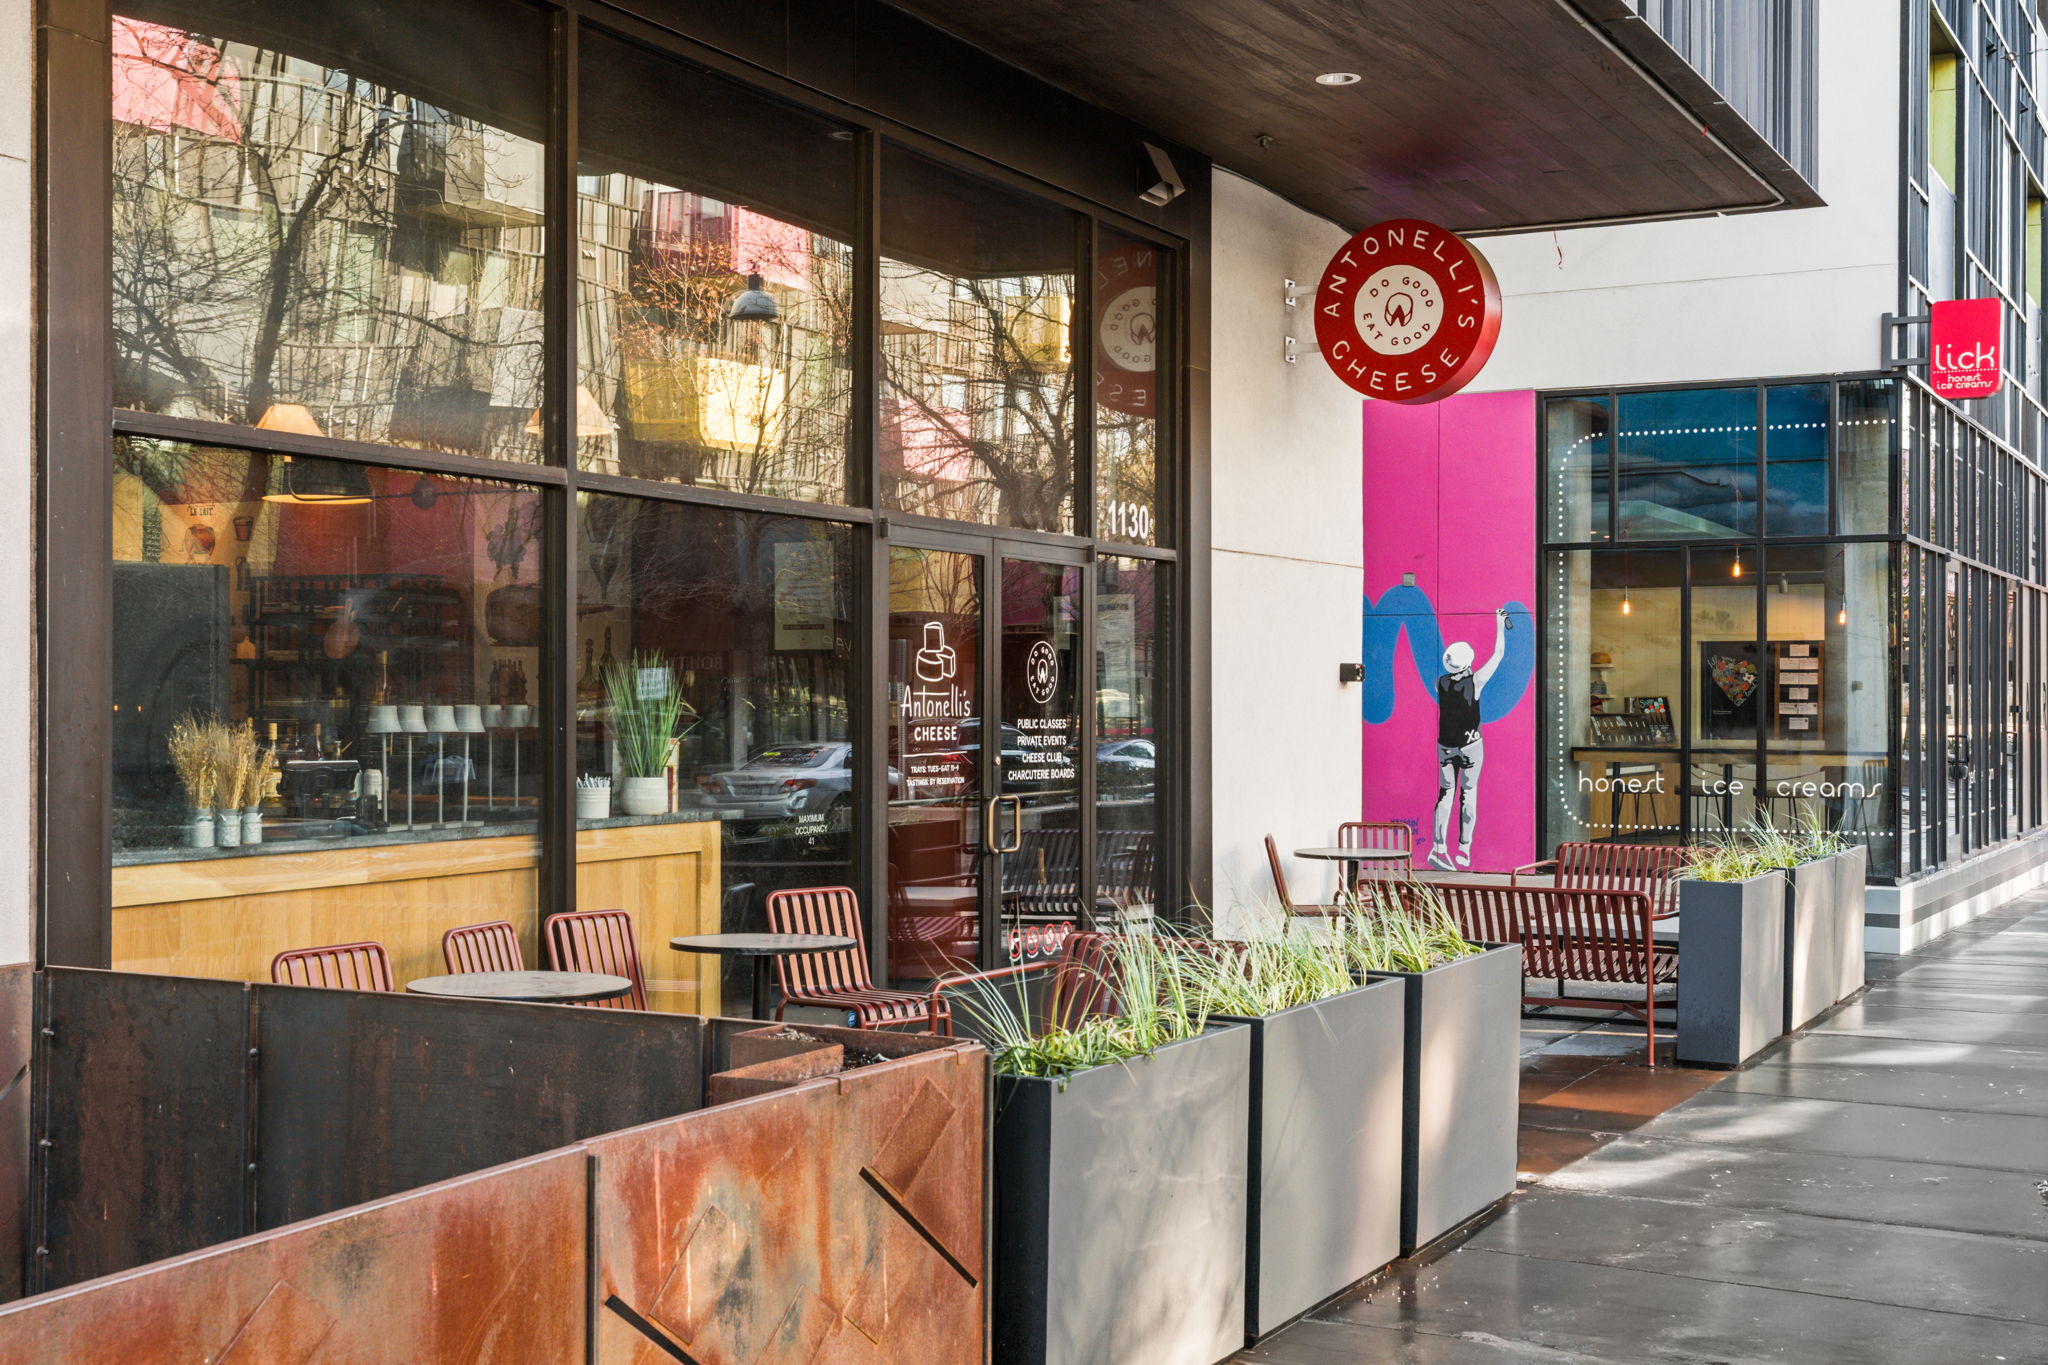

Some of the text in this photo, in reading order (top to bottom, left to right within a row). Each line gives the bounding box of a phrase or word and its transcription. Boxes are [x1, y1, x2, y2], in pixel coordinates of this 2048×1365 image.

[1323, 227, 1479, 328] ANTONELLI'S
[1370, 276, 1433, 307] DO GOOD
[1363, 312, 1430, 346] EAT GOOD
[1935, 342, 1995, 370] lick
[1332, 340, 1460, 392] CHEESE
[1947, 372, 1981, 382] honest
[1936, 380, 1993, 390] ice creams
[1108, 500, 1149, 540] 1130
[1041, 646, 1055, 666] GOOD
[1041, 676, 1055, 696] GOOD
[900, 683, 971, 717] Antonelli's
[1017, 718, 1067, 729] PUBLIC CLASSES
[914, 726, 958, 741] CHEESE
[1017, 735, 1067, 746] PRIVATE EVENTS
[1022, 751, 1062, 763] CHEESE CLUB
[930, 778, 936, 786] BY
[1008, 768, 1075, 781] CHARCUTERIE BOARDS
[1578, 769, 1883, 798] honest ice creams
[798, 813, 825, 823] MAXIMUM
[795, 824, 828, 836] OCCUPANCY
[808, 837, 815, 845] 41
